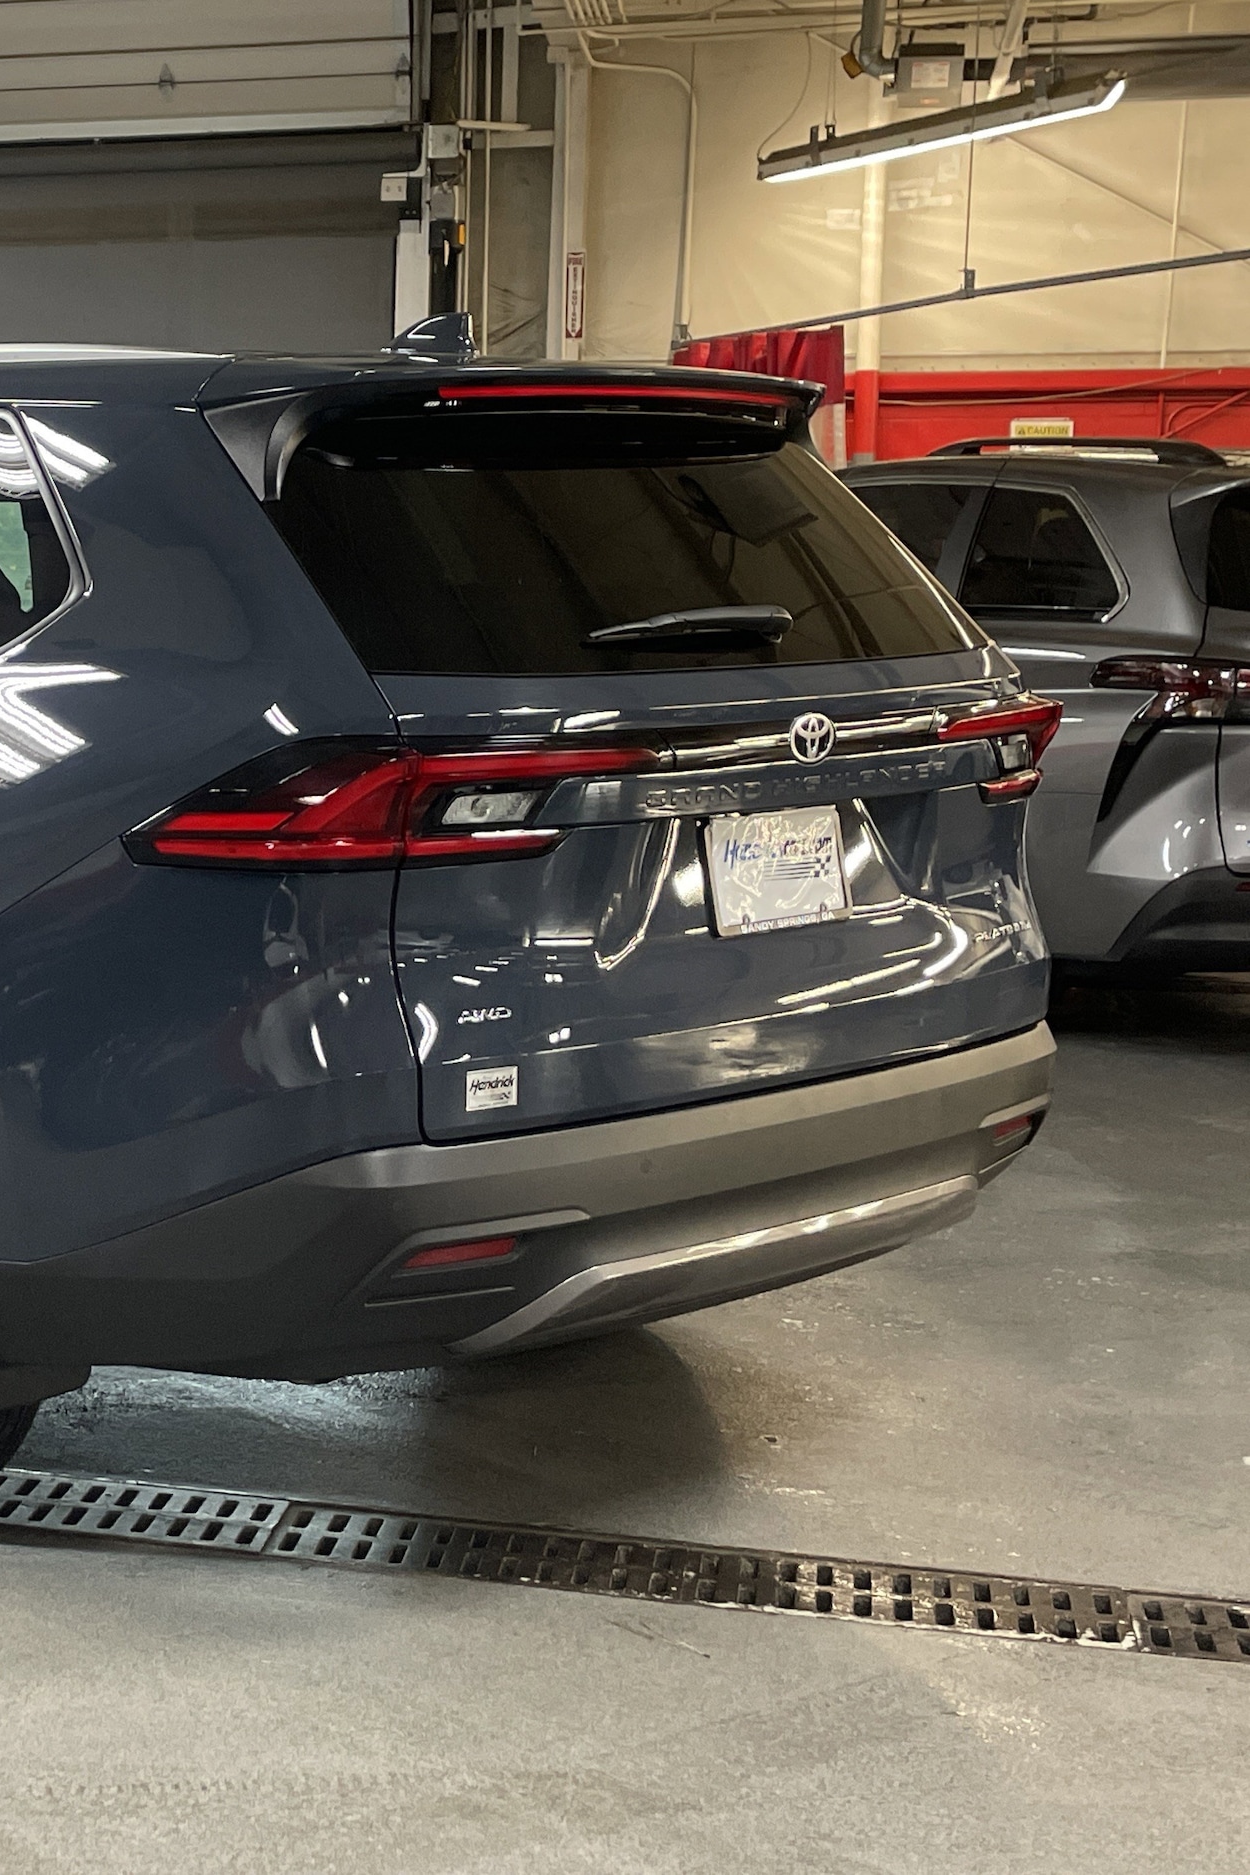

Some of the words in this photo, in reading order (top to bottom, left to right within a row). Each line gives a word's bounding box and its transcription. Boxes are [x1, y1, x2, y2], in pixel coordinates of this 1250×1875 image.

[1027, 426, 1068, 435] CAUTION
[645, 780, 761, 808] GRAND
[772, 760, 947, 796] HIGHLANDER
[740, 919, 775, 935] SANDY
[821, 910, 836, 921] GA
[457, 1007, 512, 1024] AWD
[469, 1074, 515, 1095] Hendrick
